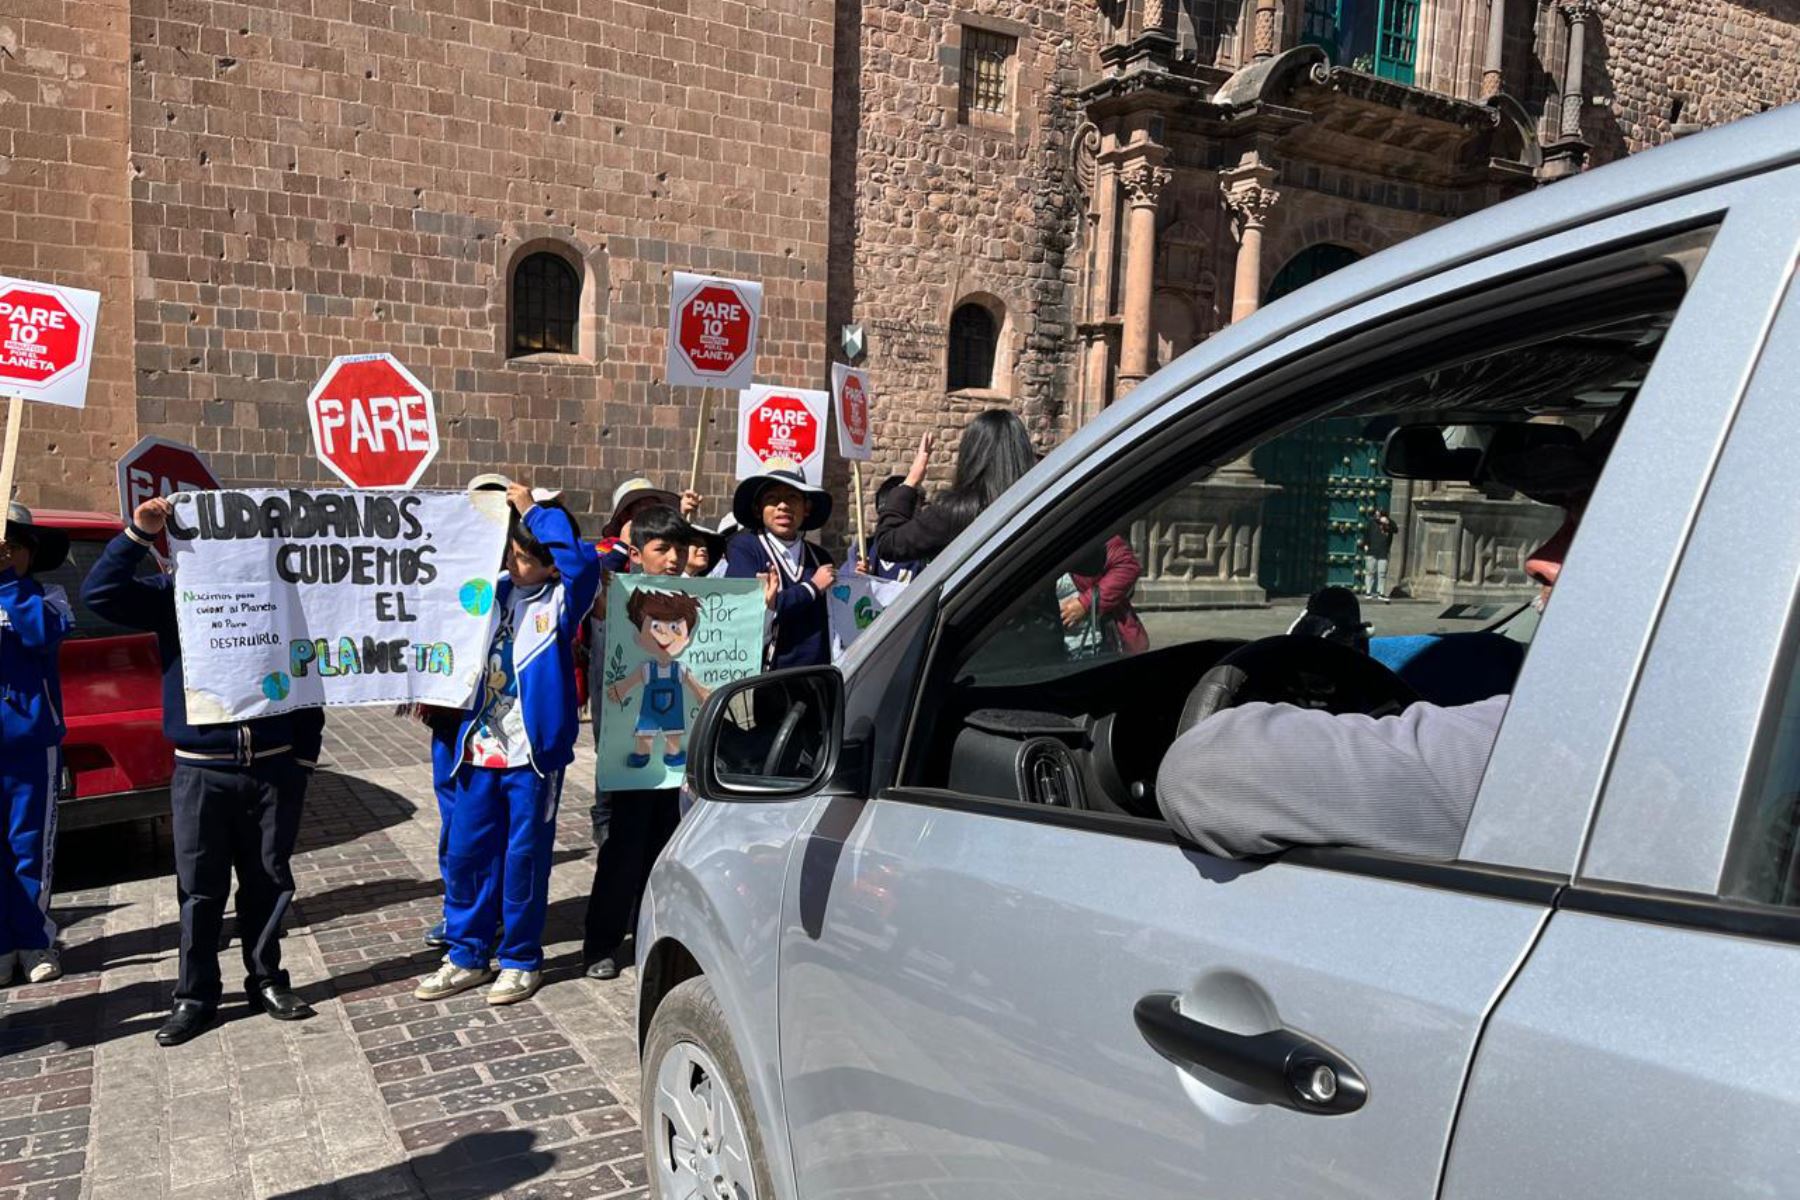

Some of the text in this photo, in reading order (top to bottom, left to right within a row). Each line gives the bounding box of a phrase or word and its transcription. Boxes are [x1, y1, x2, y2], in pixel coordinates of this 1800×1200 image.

[692, 300, 741, 321] PARE
[0, 354, 56, 371] LANETA
[691, 348, 735, 361] PLANETA
[318, 395, 430, 454] PARE
[760, 406, 808, 427] PARE
[165, 489, 432, 541] CIUDADANOS,
[276, 543, 438, 586] CUIDEMOS
[183, 591, 232, 602] Nacimos
[375, 591, 417, 622] EL
[705, 591, 738, 623] Por
[697, 628, 722, 644] un
[289, 635, 454, 678] PLANETA
[689, 638, 748, 664] mundo
[703, 664, 753, 682] mejor
